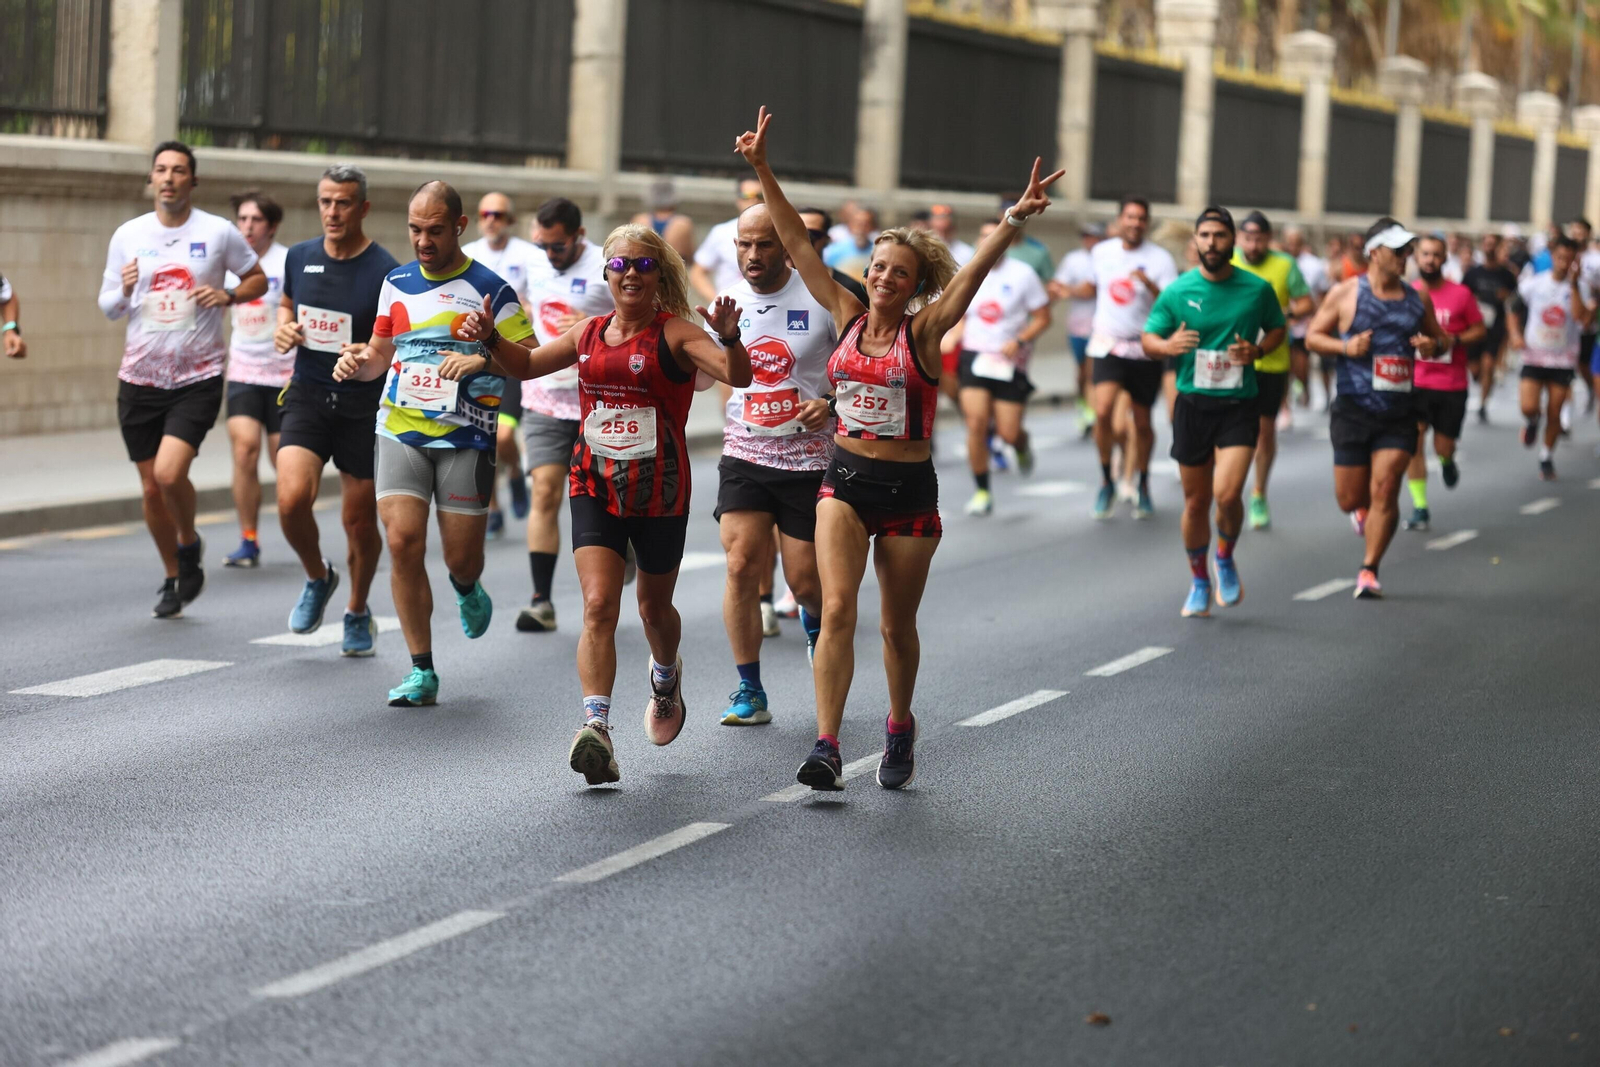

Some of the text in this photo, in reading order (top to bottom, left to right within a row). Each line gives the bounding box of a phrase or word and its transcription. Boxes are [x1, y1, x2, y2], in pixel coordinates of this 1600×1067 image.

[158, 301, 176, 311] 31
[309, 319, 338, 332] 388
[787, 320, 805, 329] AXA
[751, 349, 788, 367] PONLE
[750, 360, 785, 375] FRENO
[411, 375, 442, 389] 321
[603, 390, 626, 398] Deporte
[751, 399, 793, 415] 2499
[852, 394, 888, 410] 257
[601, 420, 639, 434] 256
